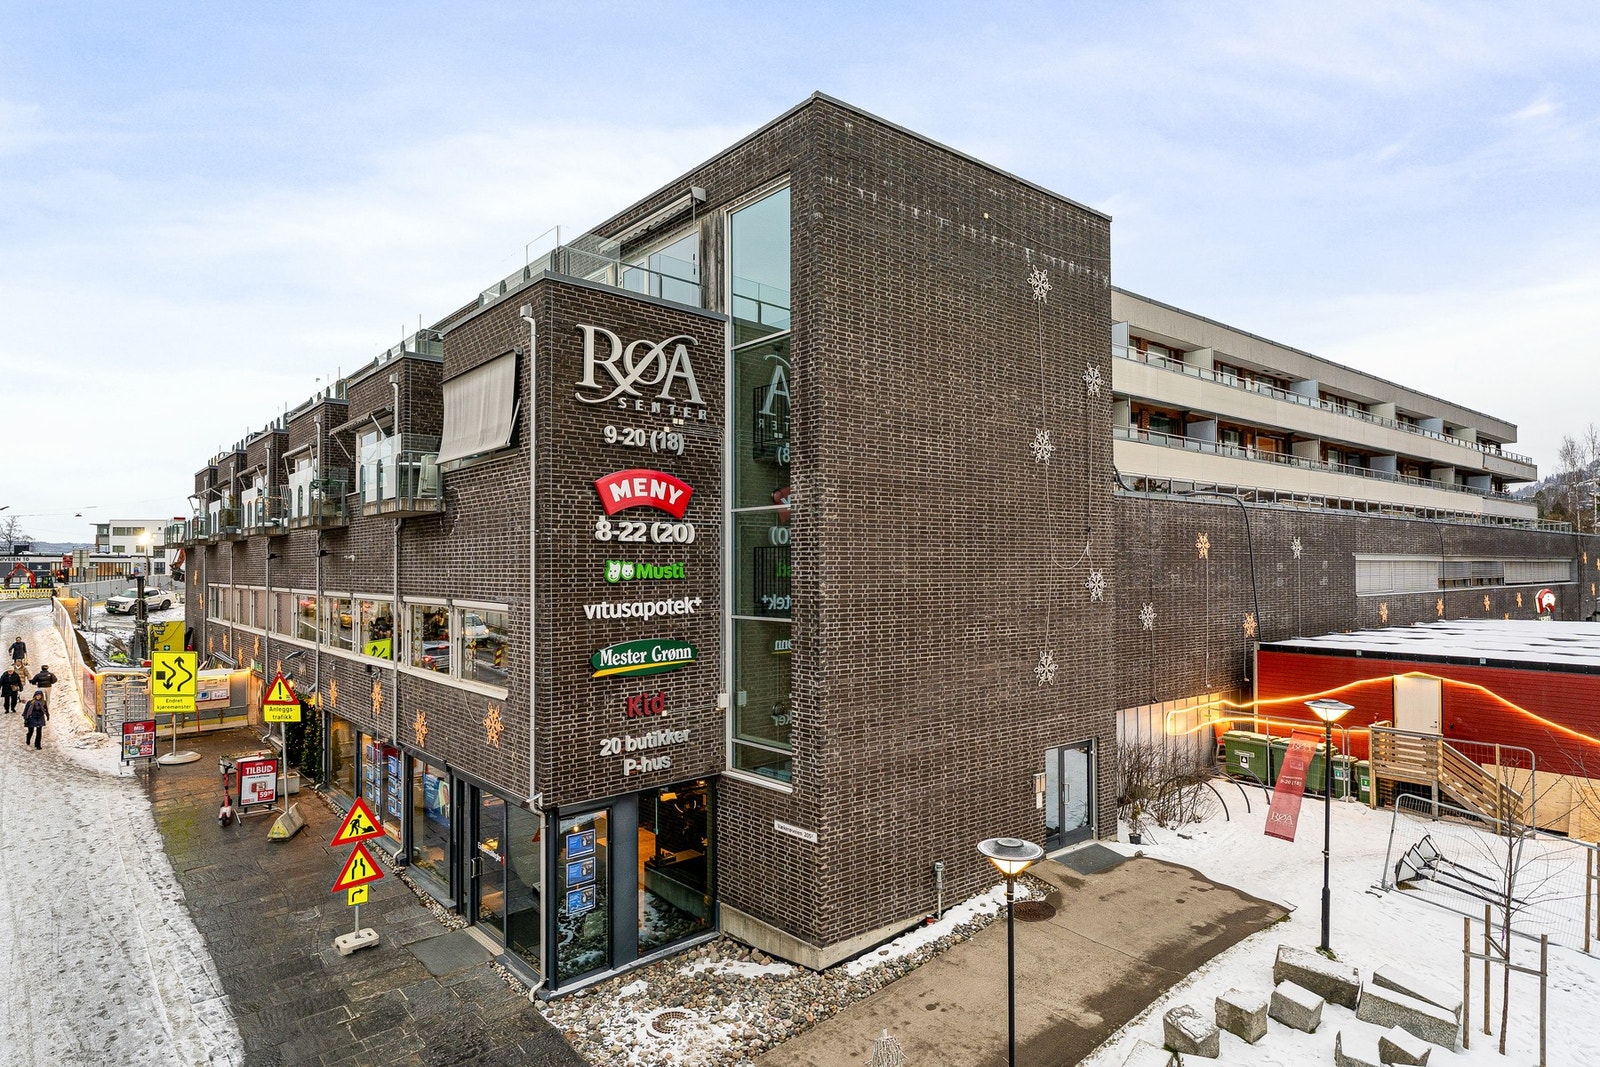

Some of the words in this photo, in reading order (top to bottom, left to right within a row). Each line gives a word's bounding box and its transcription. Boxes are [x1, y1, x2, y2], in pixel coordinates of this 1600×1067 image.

[575, 324, 707, 405] RØA
[618, 397, 708, 421] SENTER
[604, 425, 646, 447] 9-20
[650, 431, 685, 456] (18)
[609, 478, 684, 505] MENY
[594, 519, 647, 543] 8-22
[650, 522, 695, 544] (20)
[636, 562, 686, 580] Musti
[600, 649, 647, 667] Mester
[651, 646, 692, 663] Grønn
[599, 737, 622, 756] 20
[625, 728, 692, 752] butikker
[623, 755, 672, 777] P-hus
